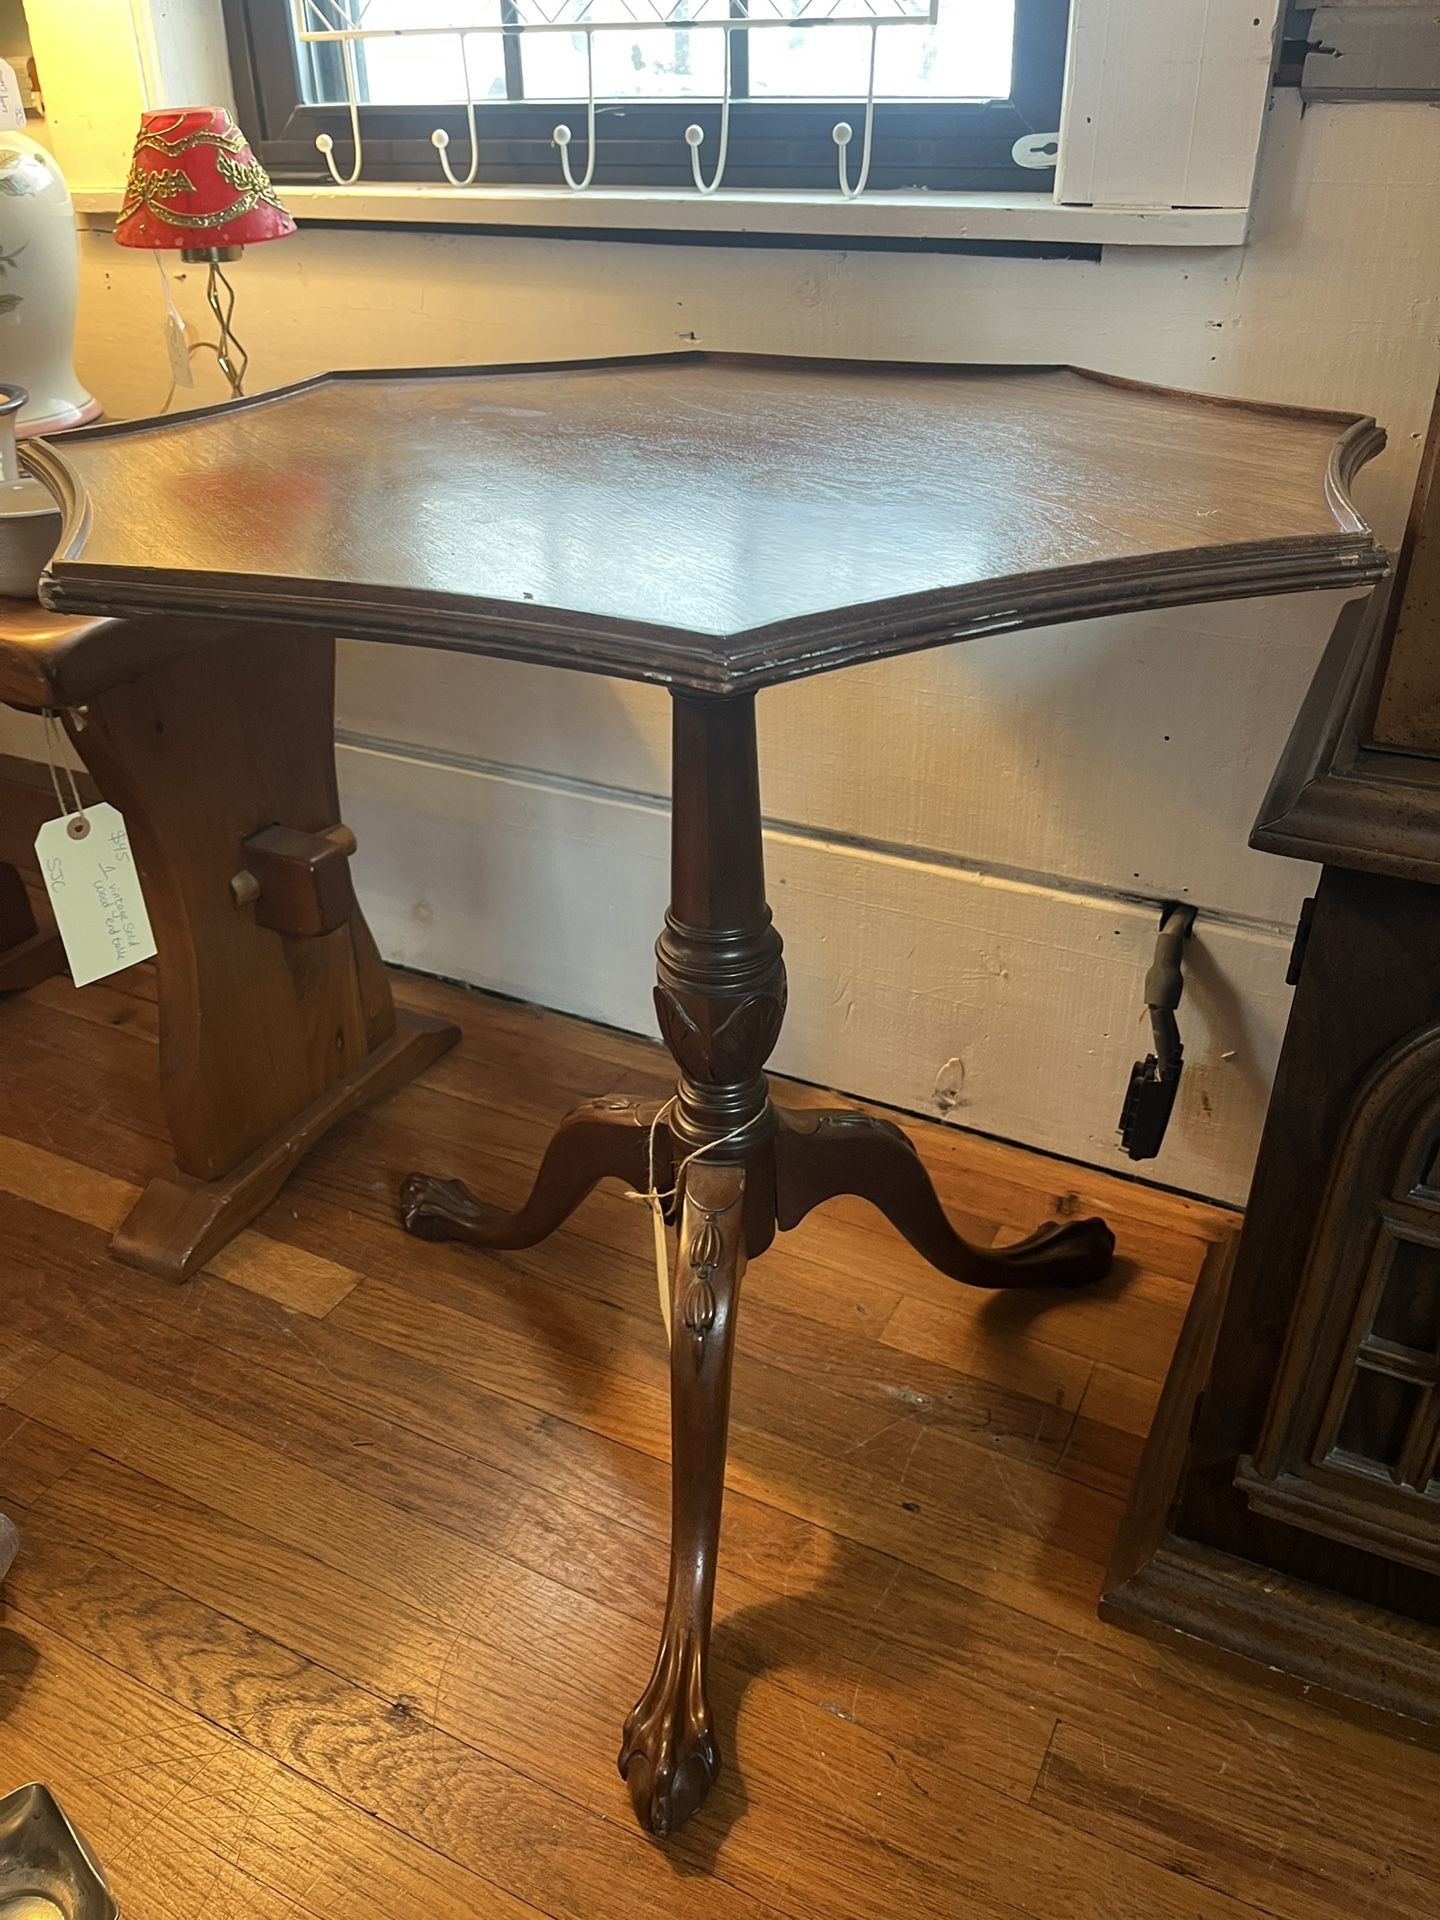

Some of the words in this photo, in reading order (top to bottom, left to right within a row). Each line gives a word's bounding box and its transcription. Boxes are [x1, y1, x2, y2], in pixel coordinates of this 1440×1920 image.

[108, 830, 130, 861] $45
[47, 857, 66, 894] SJC
[98, 862, 116, 880] 1
[105, 918, 121, 935] end
